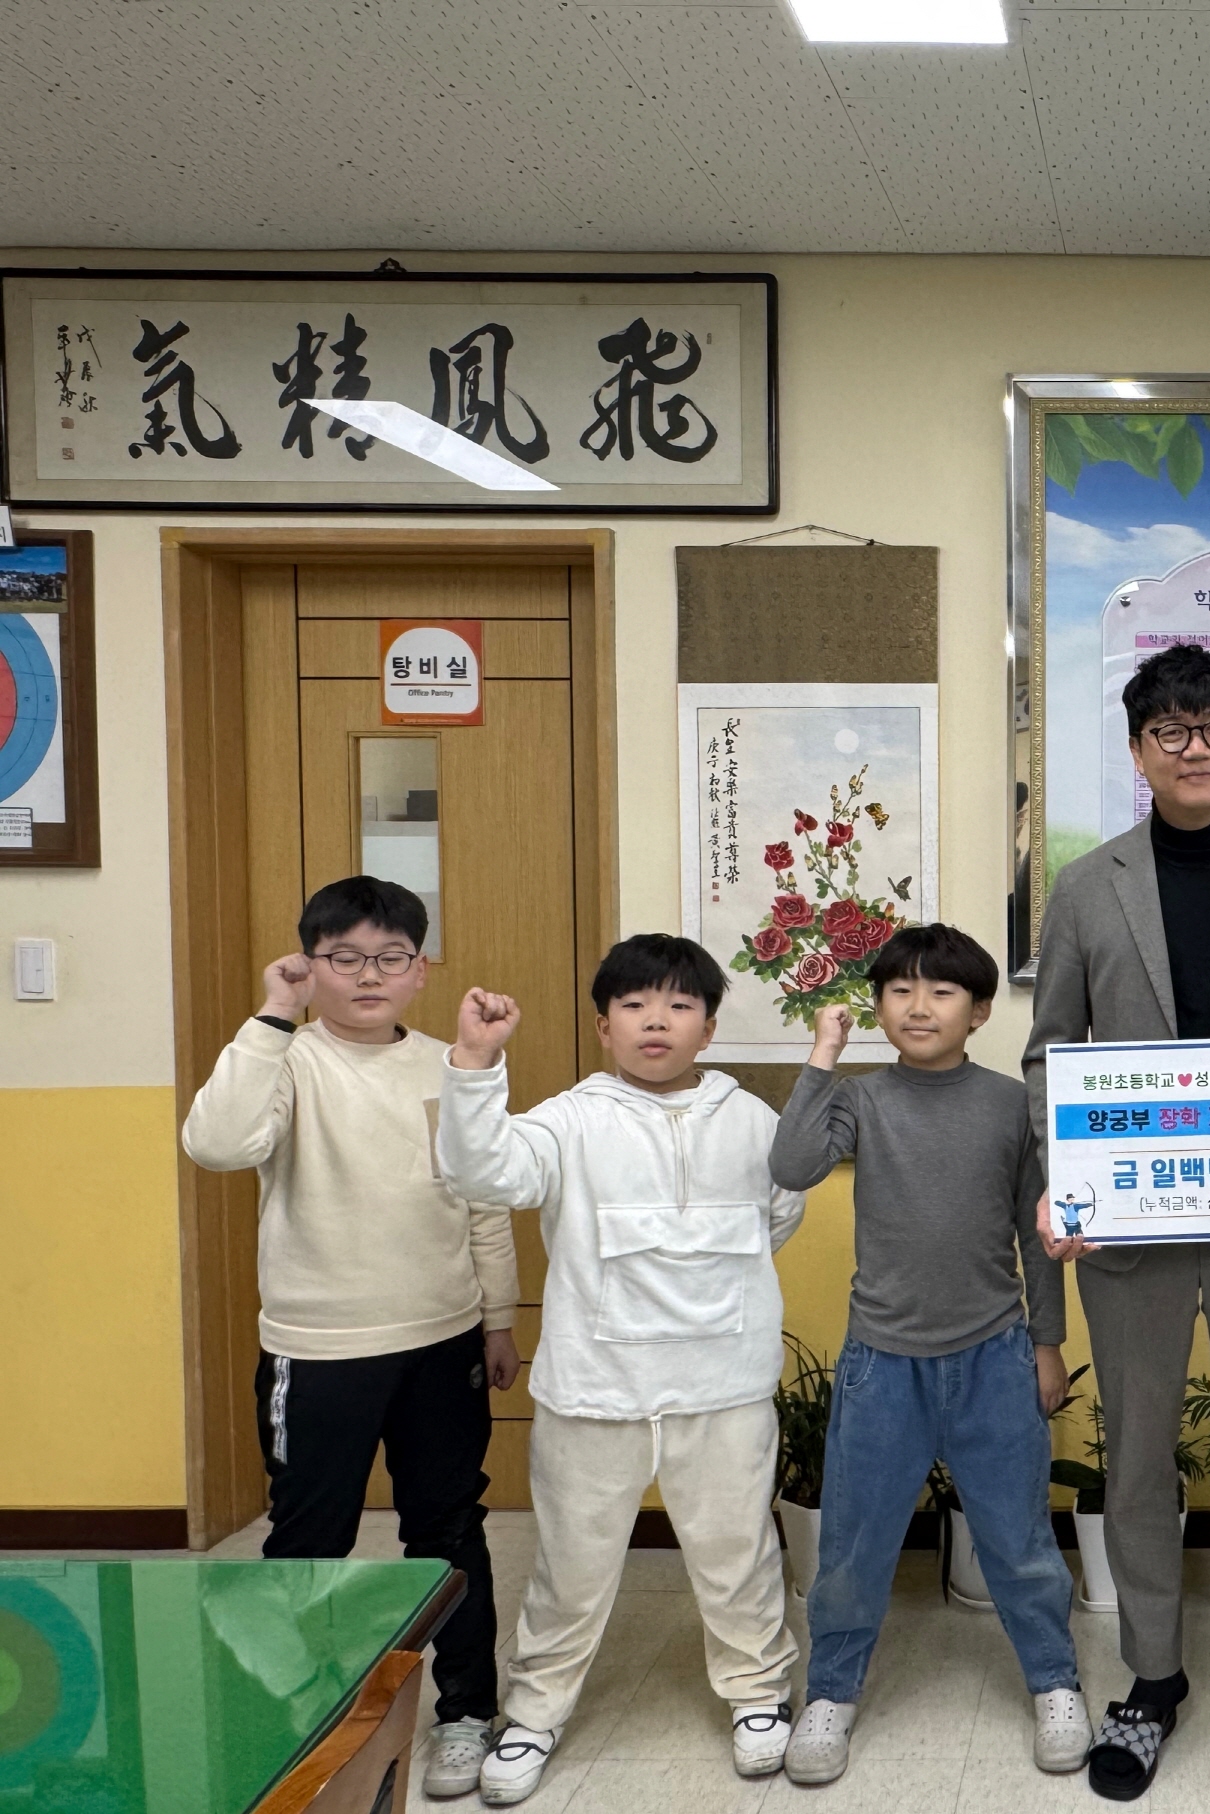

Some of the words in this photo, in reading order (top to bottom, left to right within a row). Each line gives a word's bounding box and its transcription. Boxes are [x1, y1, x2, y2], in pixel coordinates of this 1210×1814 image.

[392, 656, 468, 679] 탕비실
[1083, 1072, 1174, 1091] 봉원초등학교
[1088, 1109, 1150, 1132] 양궁부
[1158, 1107, 1200, 1130] 장학
[1112, 1160, 1139, 1190] 금
